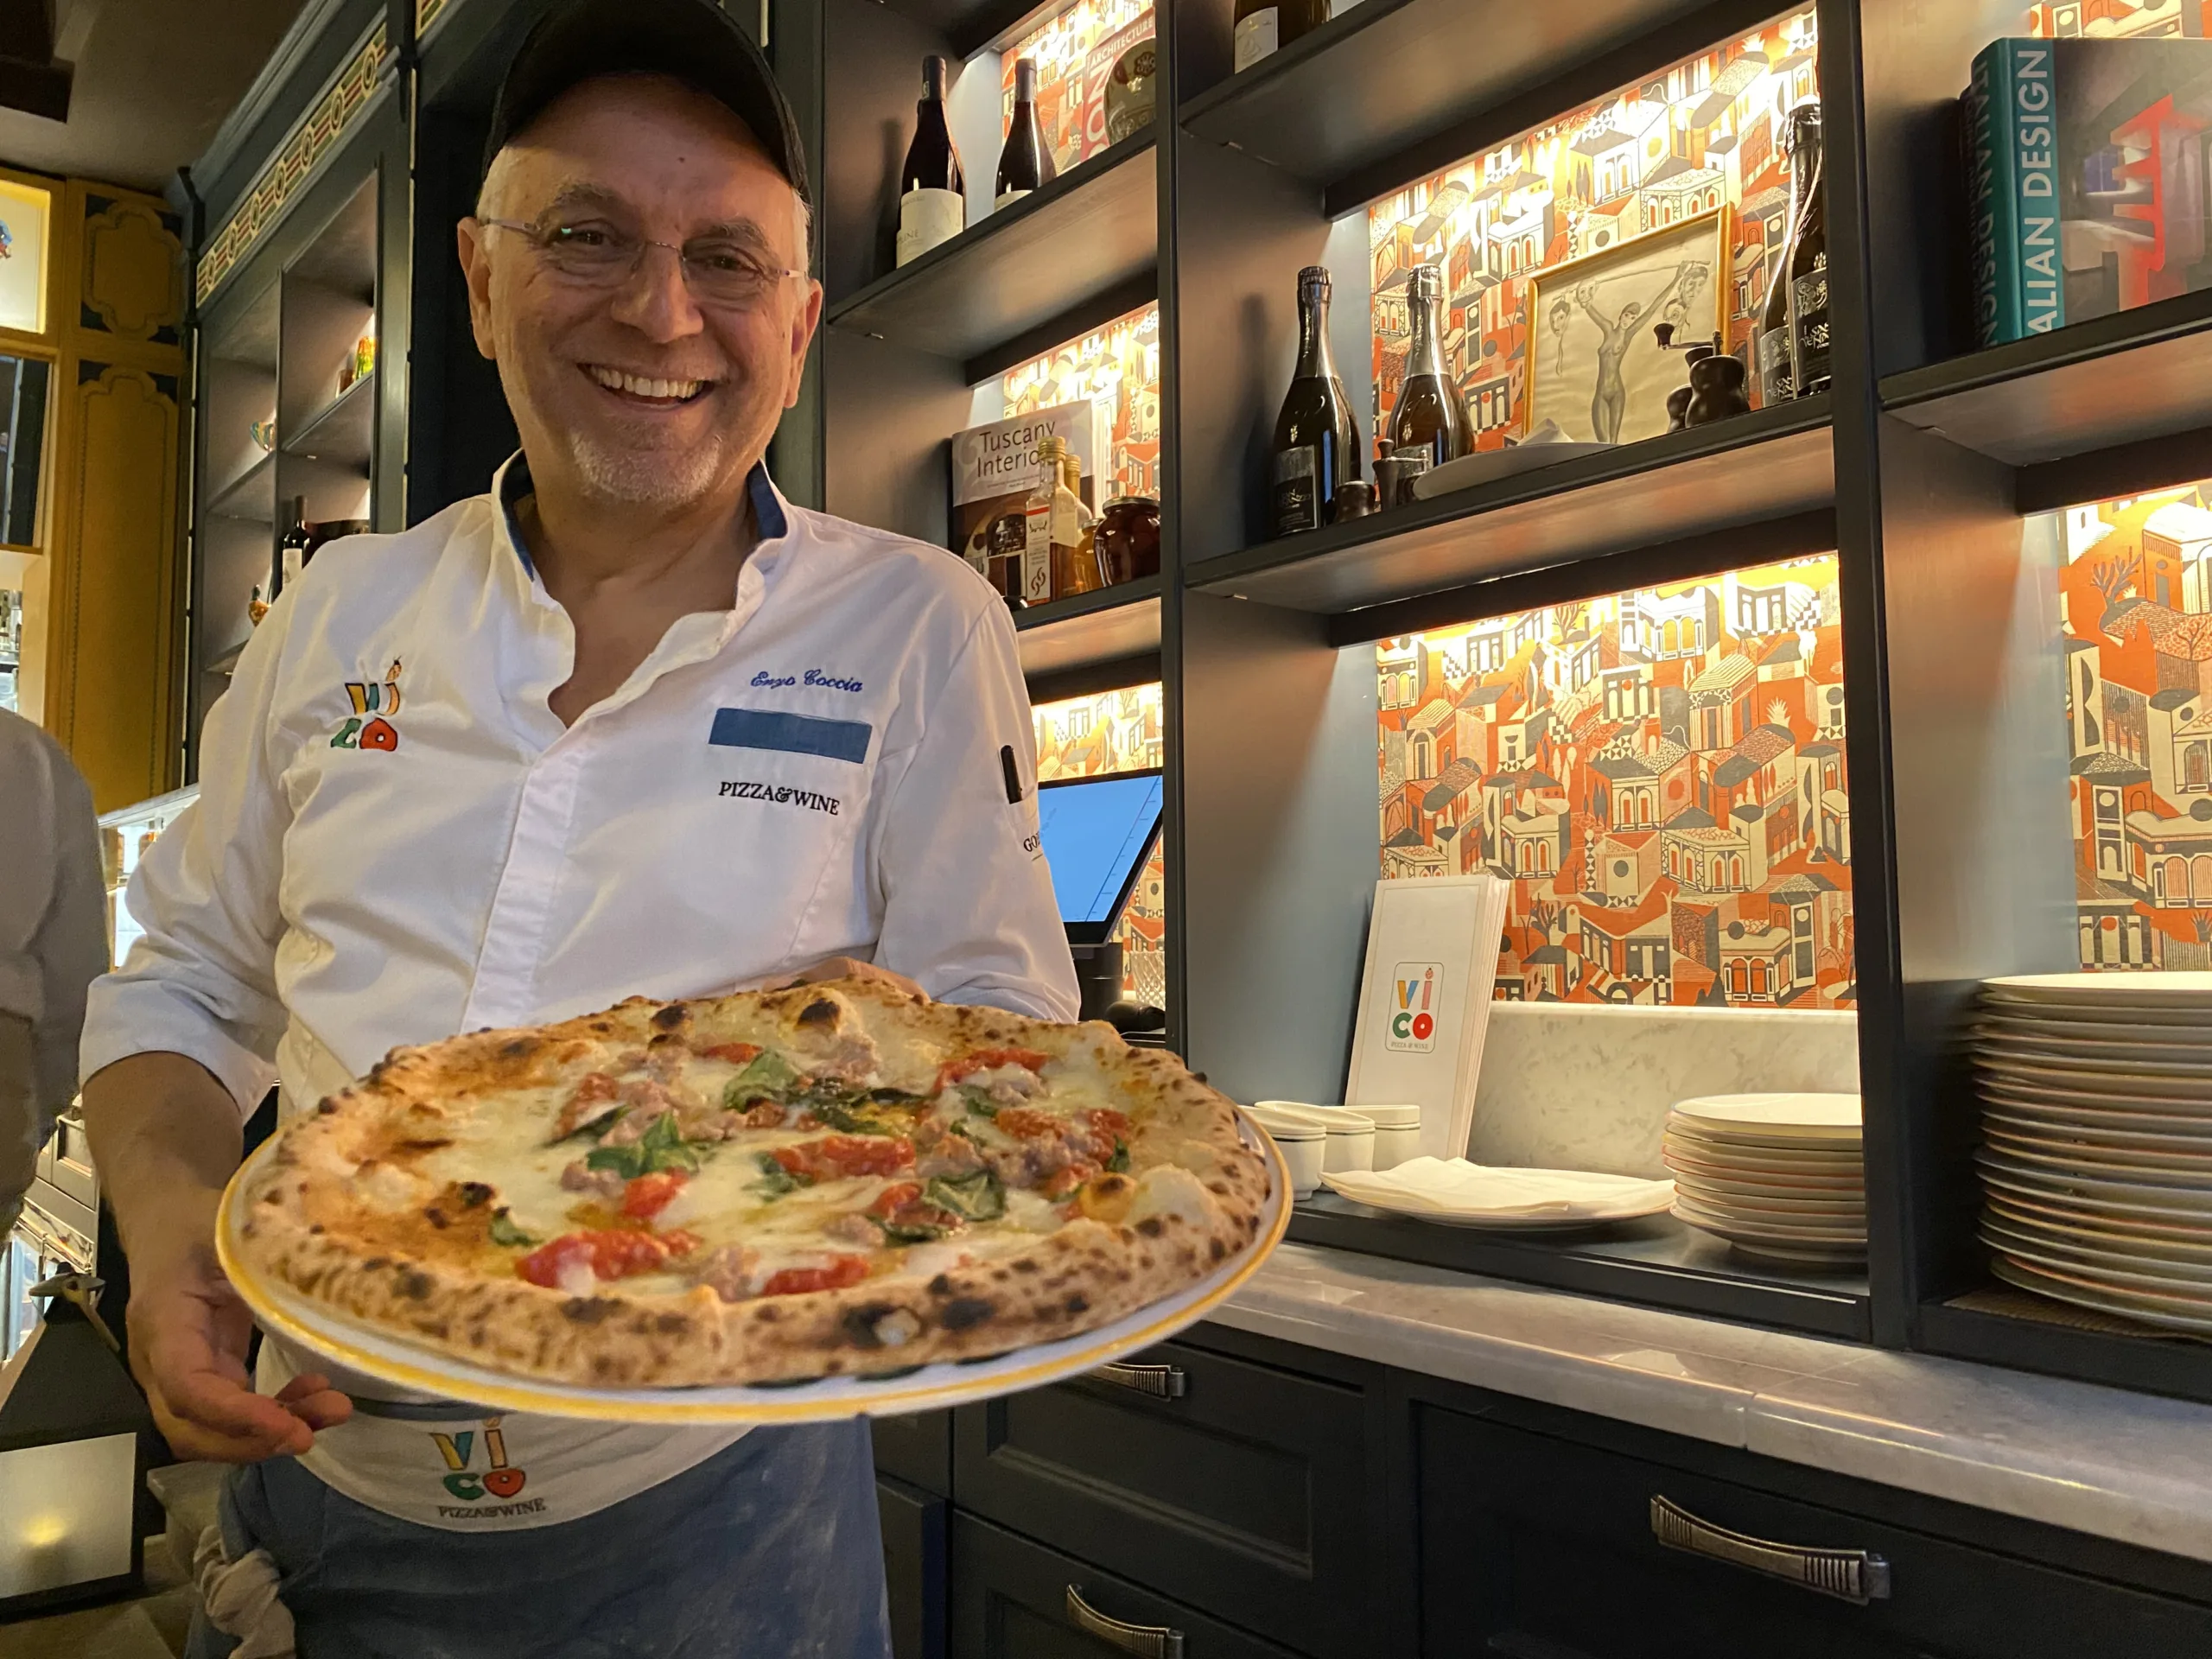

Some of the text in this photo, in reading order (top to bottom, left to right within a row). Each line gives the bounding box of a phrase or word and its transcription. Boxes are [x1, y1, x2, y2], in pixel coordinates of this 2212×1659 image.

[2017, 50, 2053, 197] DESIGN
[979, 421, 1055, 454] Tuscany
[751, 669, 863, 692] Enzo Coccia
[719, 781, 840, 815] PIZZA&WINE
